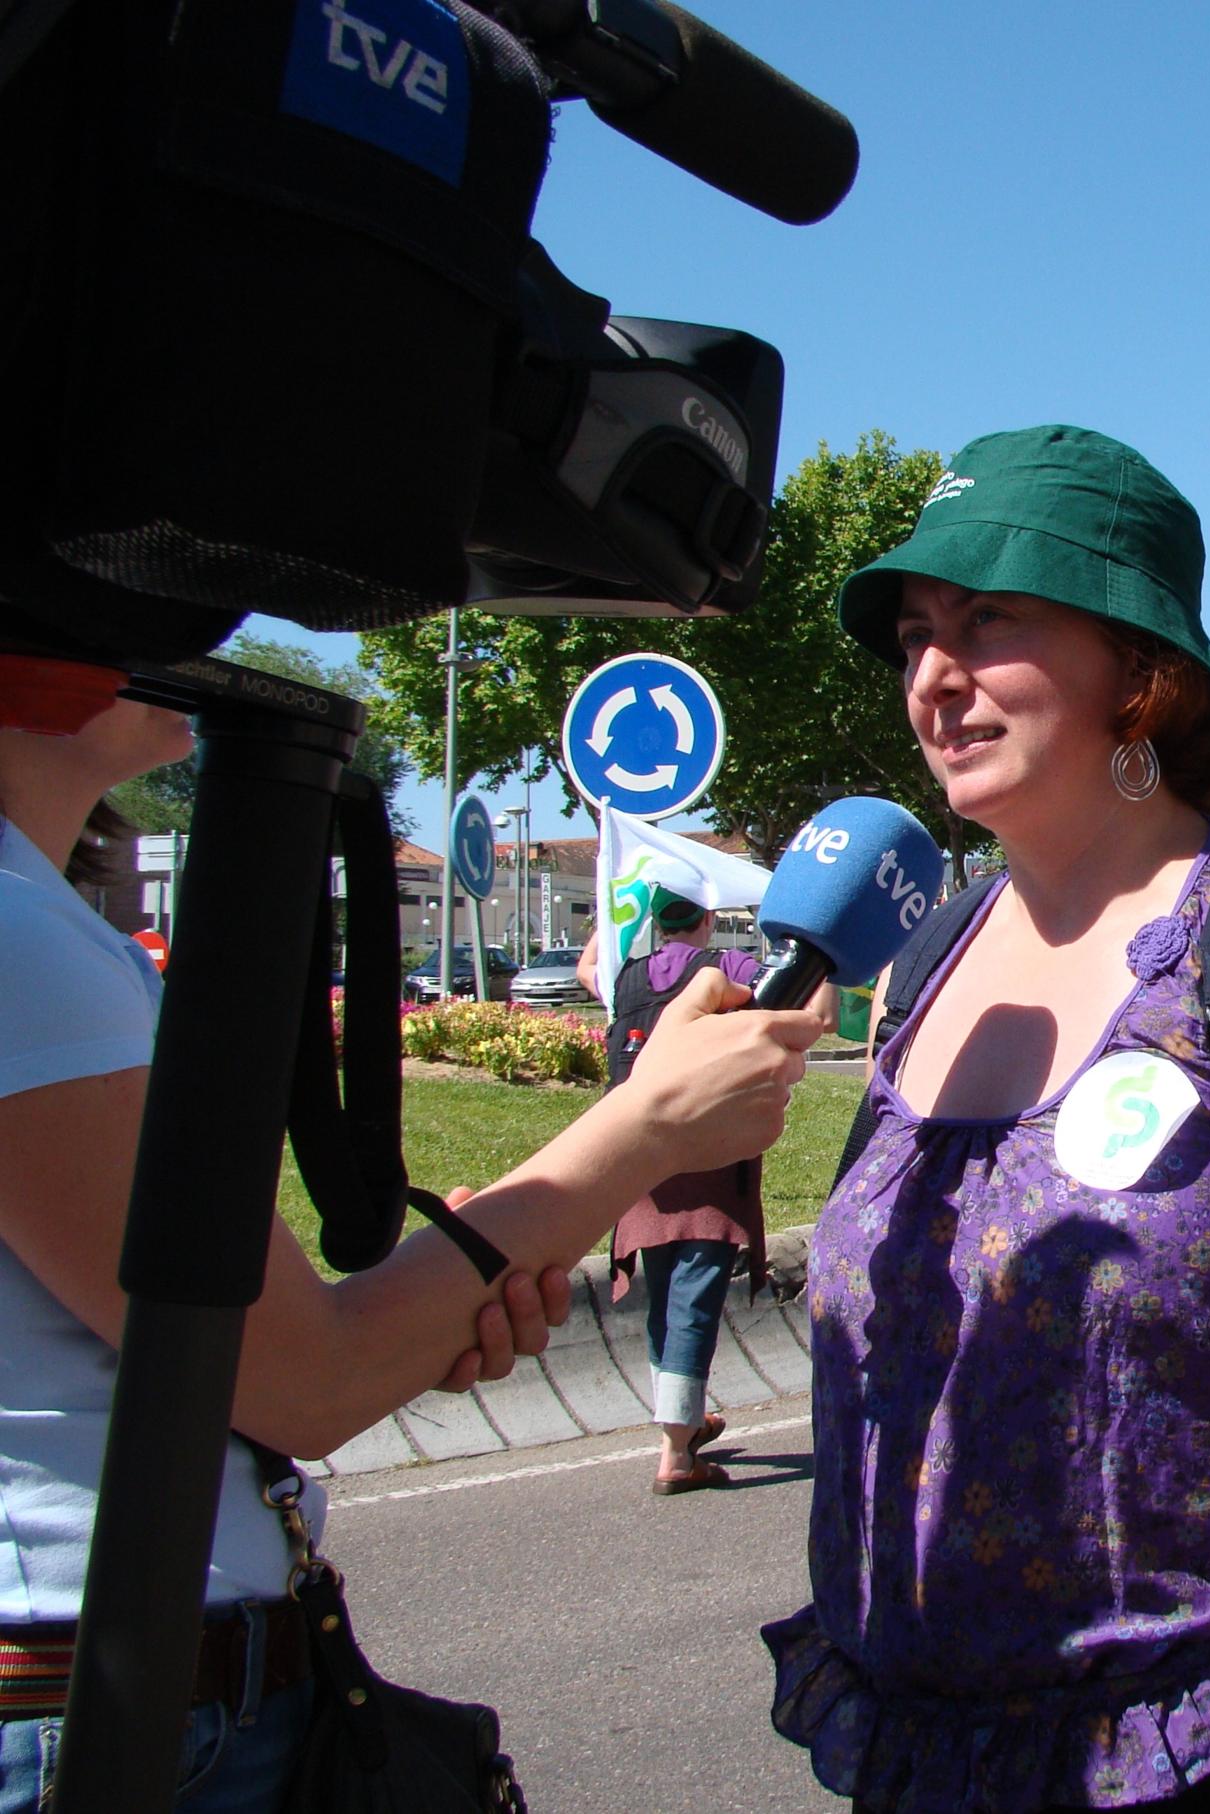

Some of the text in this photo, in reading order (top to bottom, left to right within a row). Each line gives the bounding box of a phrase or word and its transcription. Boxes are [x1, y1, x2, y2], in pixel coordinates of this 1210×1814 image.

[321, 0, 448, 115] tve
[681, 397, 743, 474] Canon
[241, 673, 330, 715] MONOPOD
[791, 821, 849, 864] tve
[542, 874, 550, 933] GARAJE
[876, 849, 926, 931] tve
